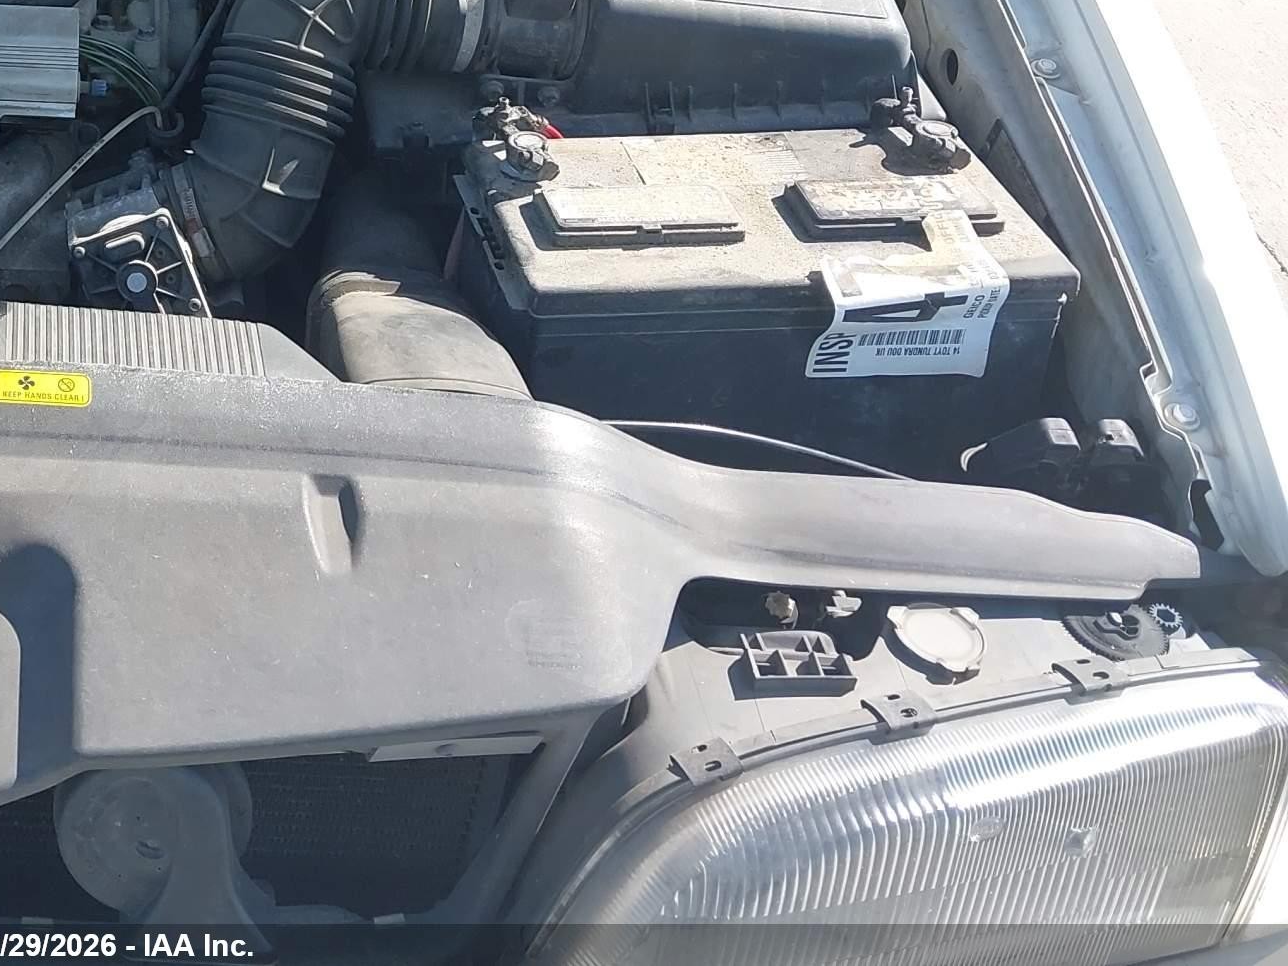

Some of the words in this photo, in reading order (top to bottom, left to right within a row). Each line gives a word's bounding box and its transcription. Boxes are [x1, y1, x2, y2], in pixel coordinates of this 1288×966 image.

[963, 295, 985, 319] GEICO
[813, 332, 857, 373] INSP
[904, 346, 934, 356] TUNDRA
[934, 347, 951, 355] TOYT
[952, 347, 960, 355] 14
[24, 392, 53, 400] HANDS
[55, 393, 80, 402] CLEAR
